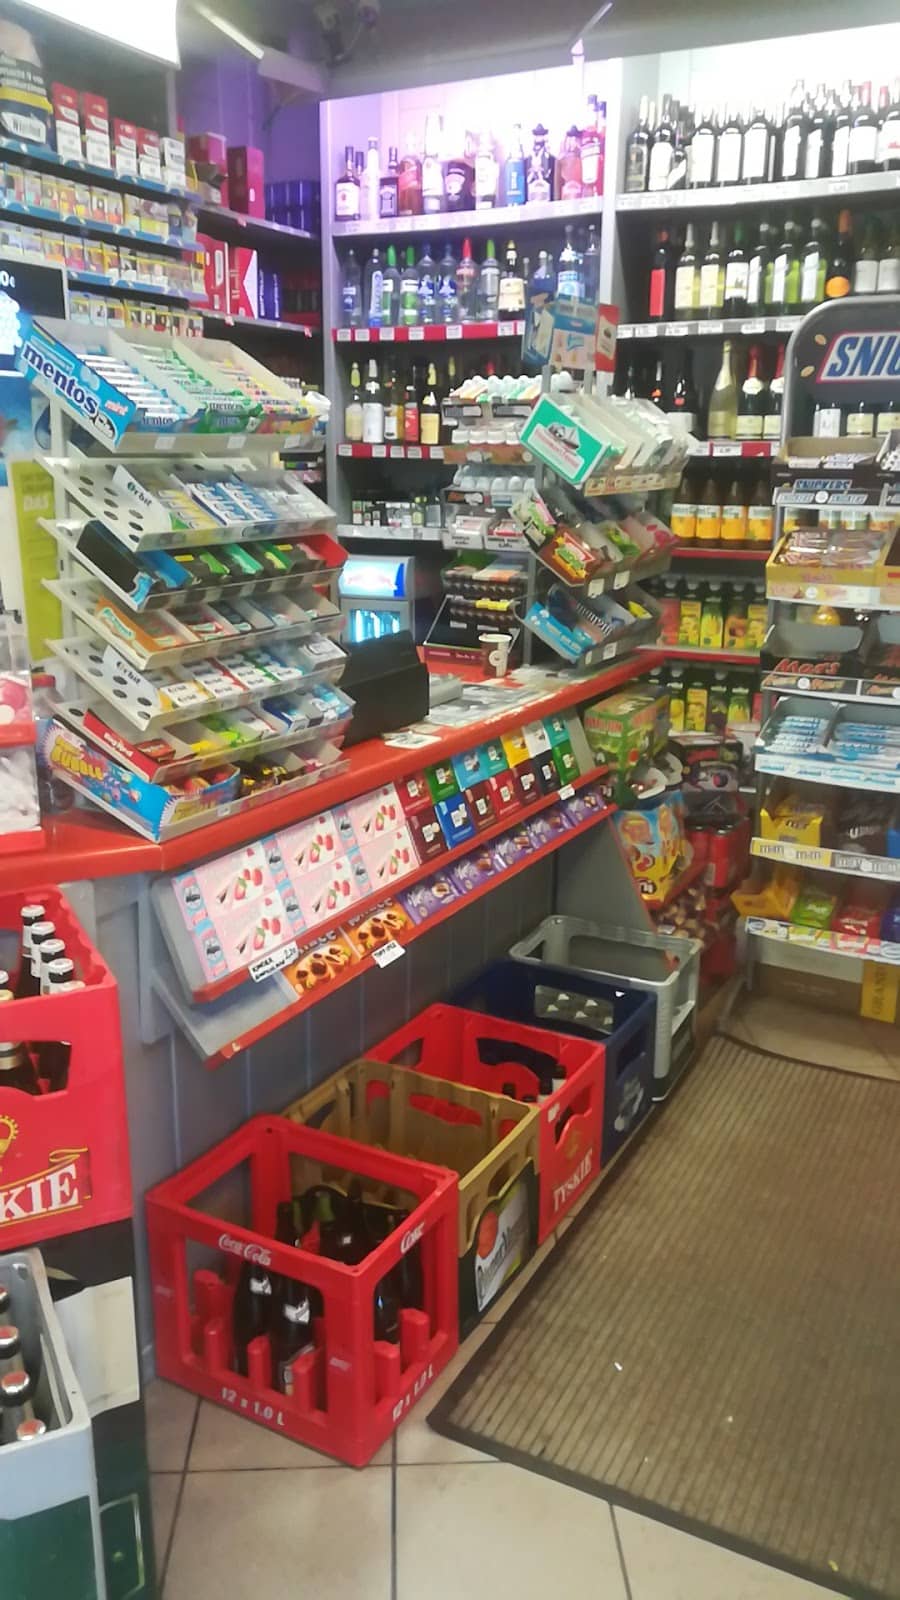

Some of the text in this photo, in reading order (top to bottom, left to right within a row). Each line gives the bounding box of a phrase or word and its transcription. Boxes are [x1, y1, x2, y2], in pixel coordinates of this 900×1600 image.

[22, 343, 99, 414] mentos
[553, 1147, 593, 1212] TYSKIE
[221, 1386, 237, 1402] 12
